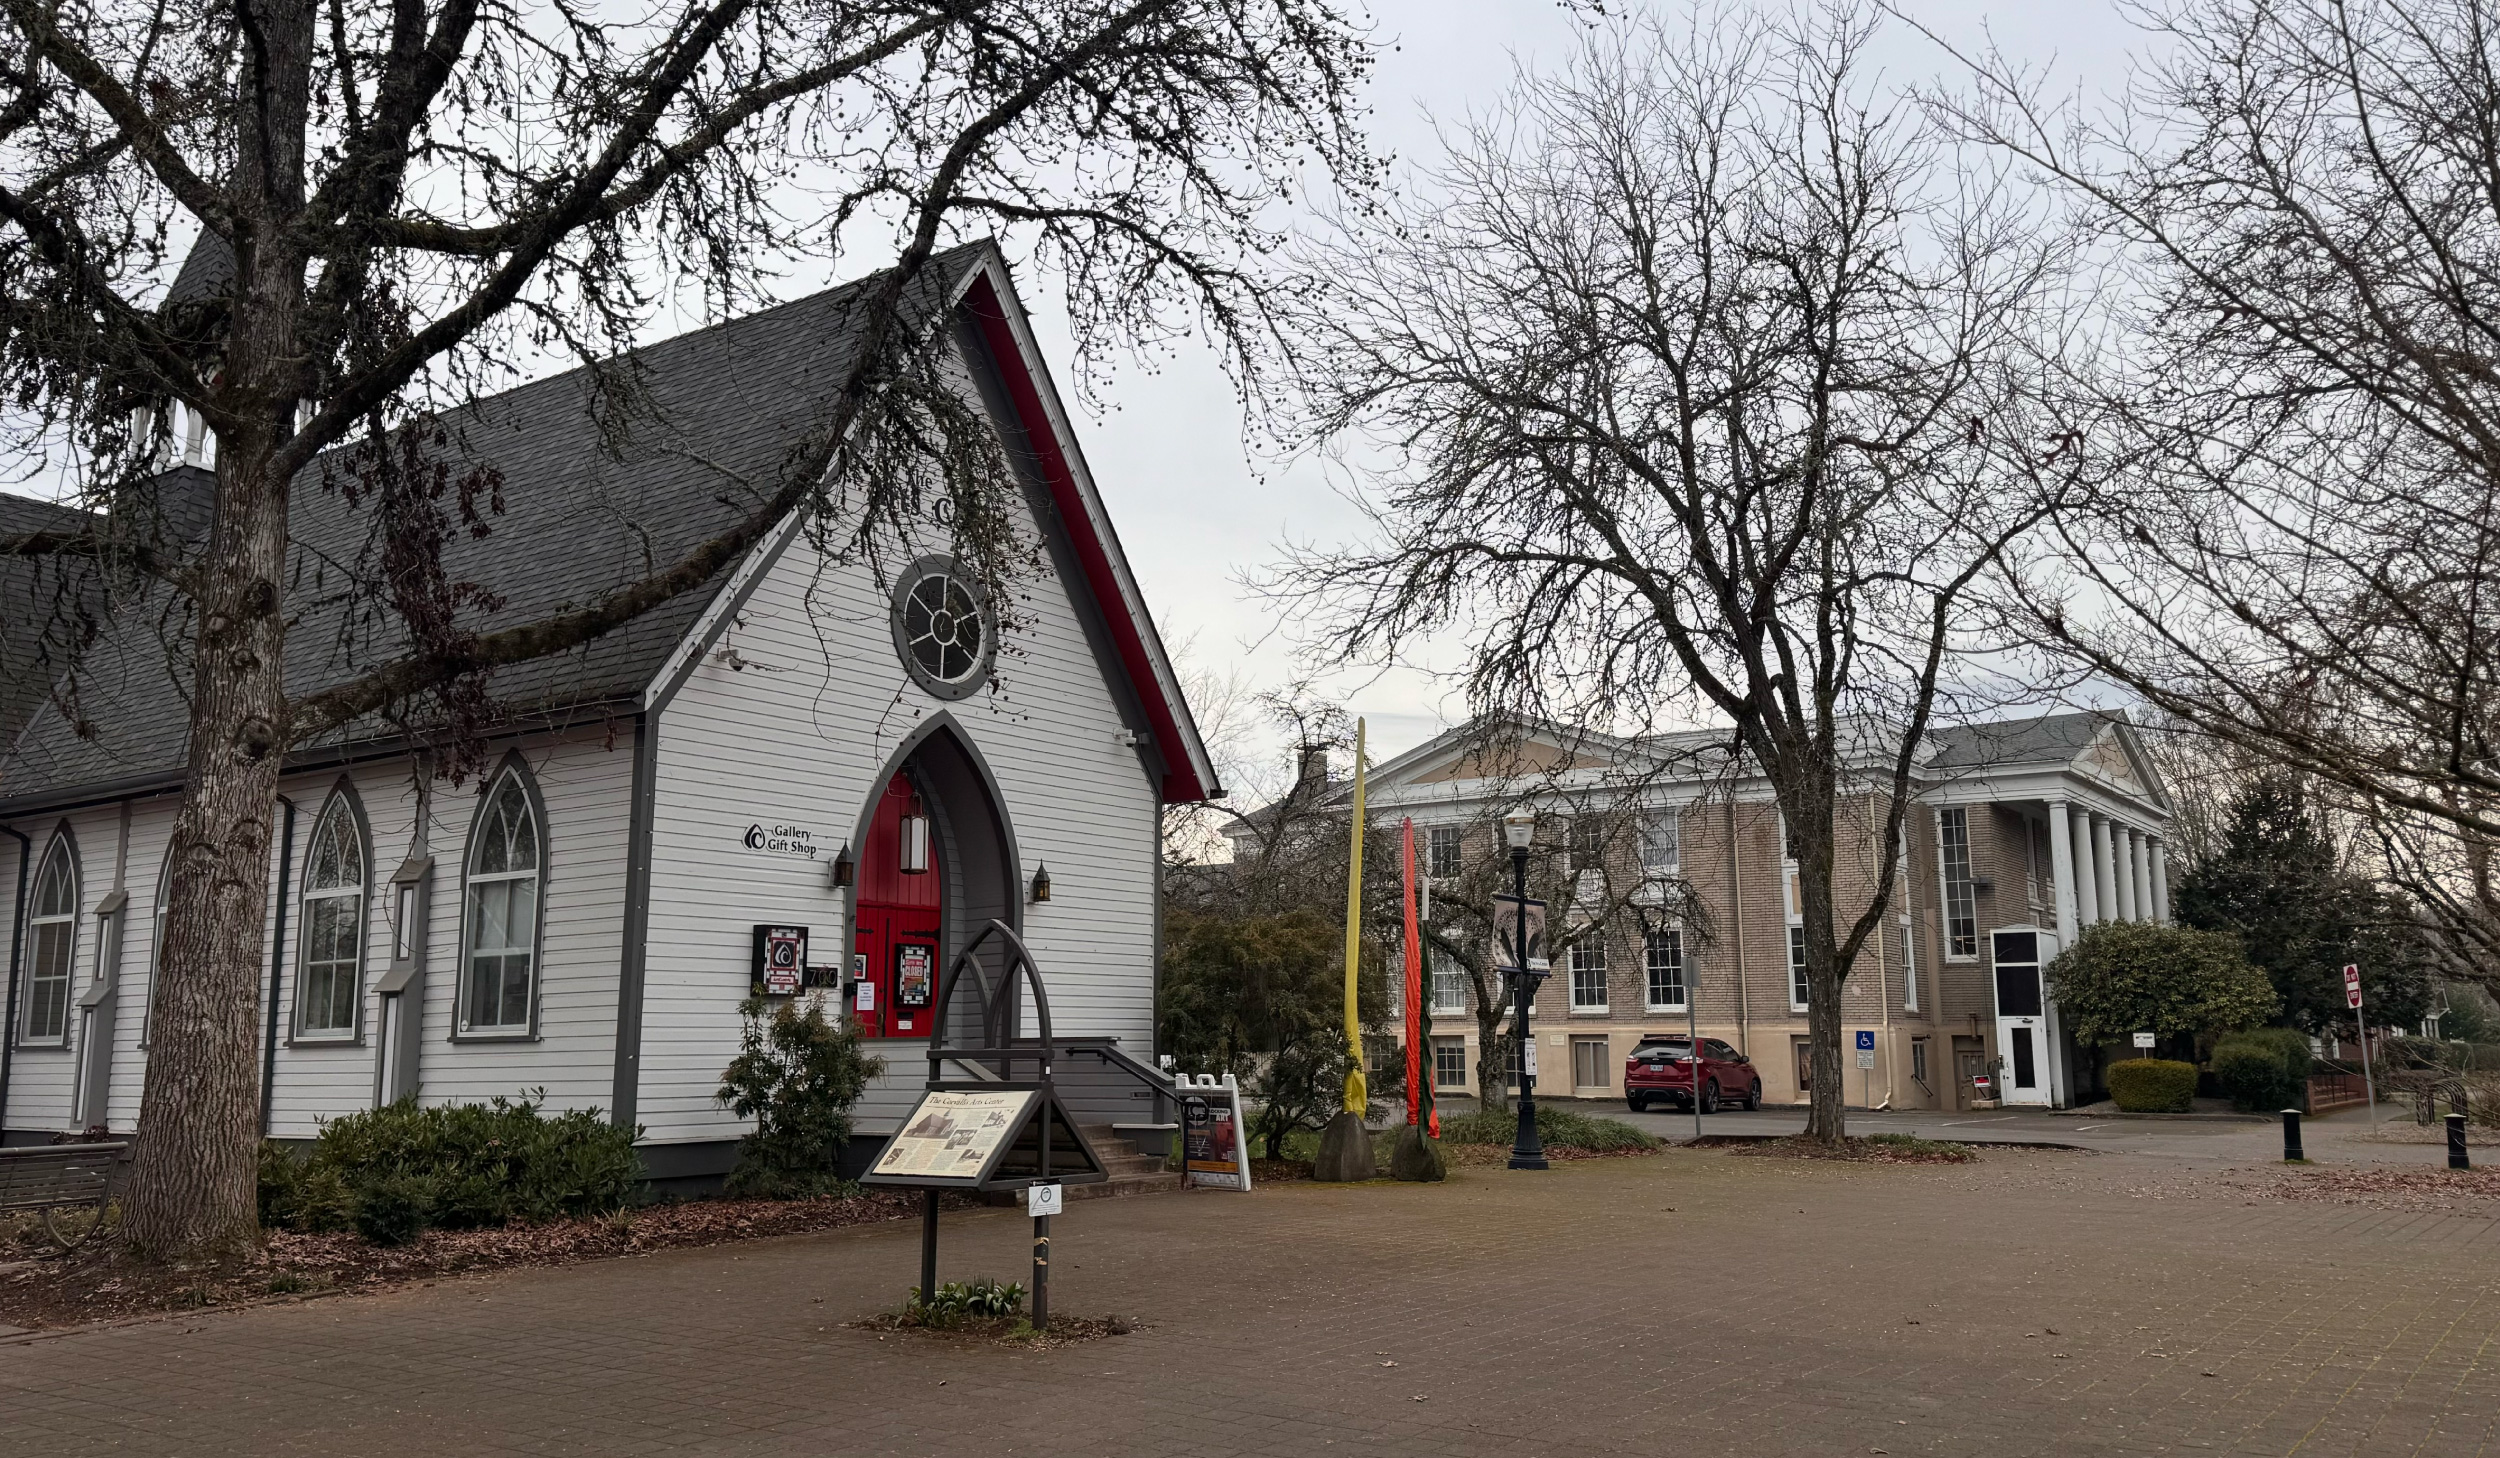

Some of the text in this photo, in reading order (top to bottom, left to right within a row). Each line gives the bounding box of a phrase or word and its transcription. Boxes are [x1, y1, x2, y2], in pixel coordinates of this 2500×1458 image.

[774, 825, 811, 842] Gallery
[768, 839, 817, 859] Gift Shop
[905, 966, 924, 977] CLOSED
[929, 1096, 1005, 1106] The Corvallis Arts Center
[1215, 1114, 1229, 1122] ART
